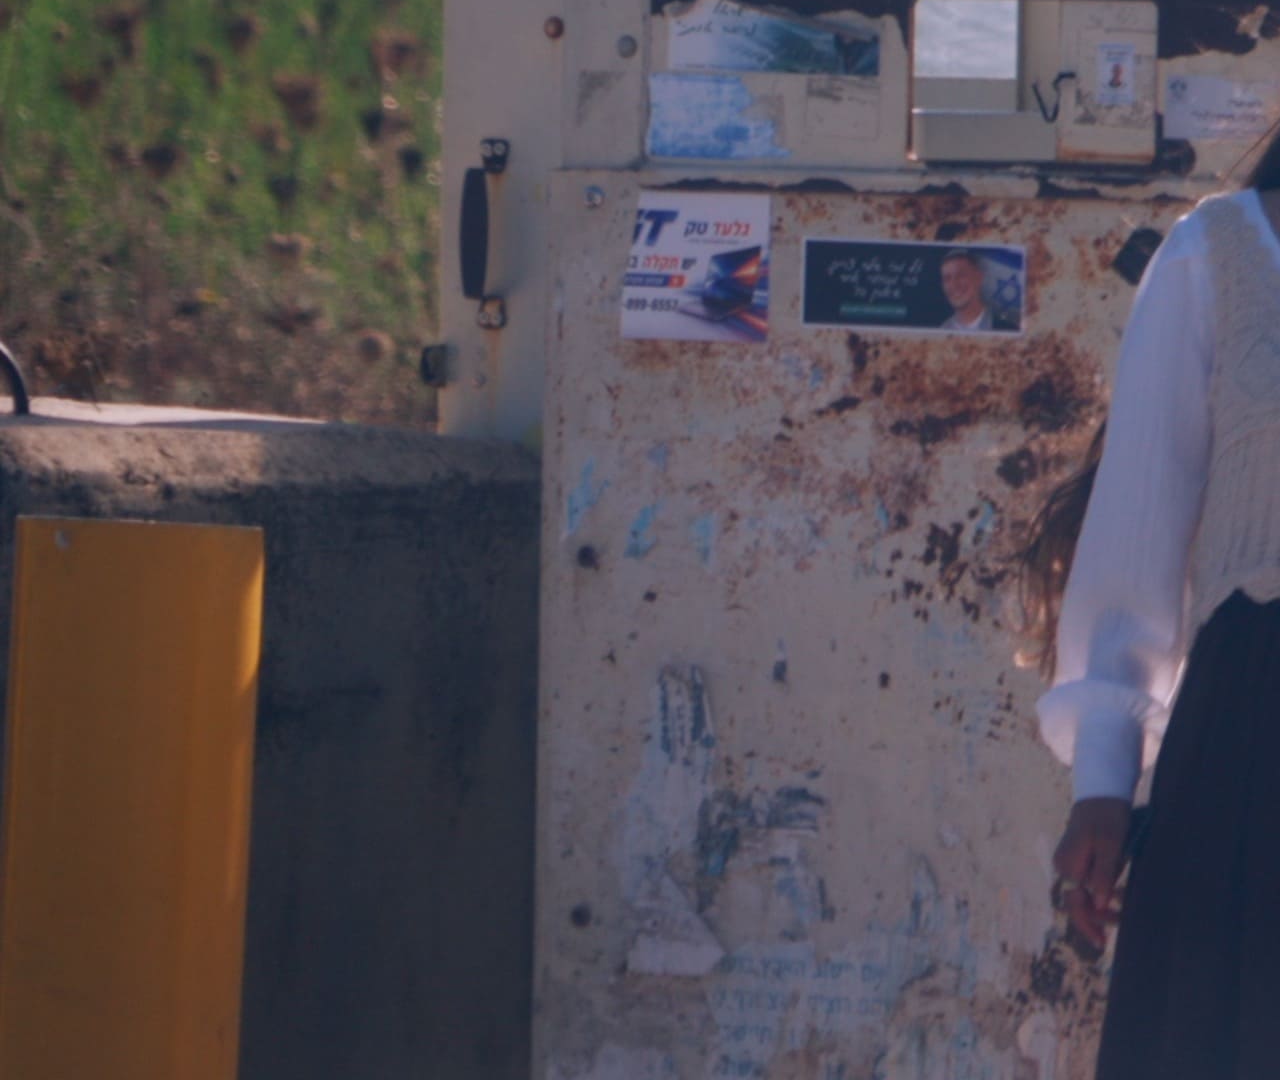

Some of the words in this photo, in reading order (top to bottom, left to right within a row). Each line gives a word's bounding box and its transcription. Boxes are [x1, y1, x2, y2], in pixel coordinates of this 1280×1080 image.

[684, 221, 709, 238] טק
[713, 221, 752, 237] גלעד
[642, 254, 680, 272] תקלה
[681, 256, 697, 270] יש
